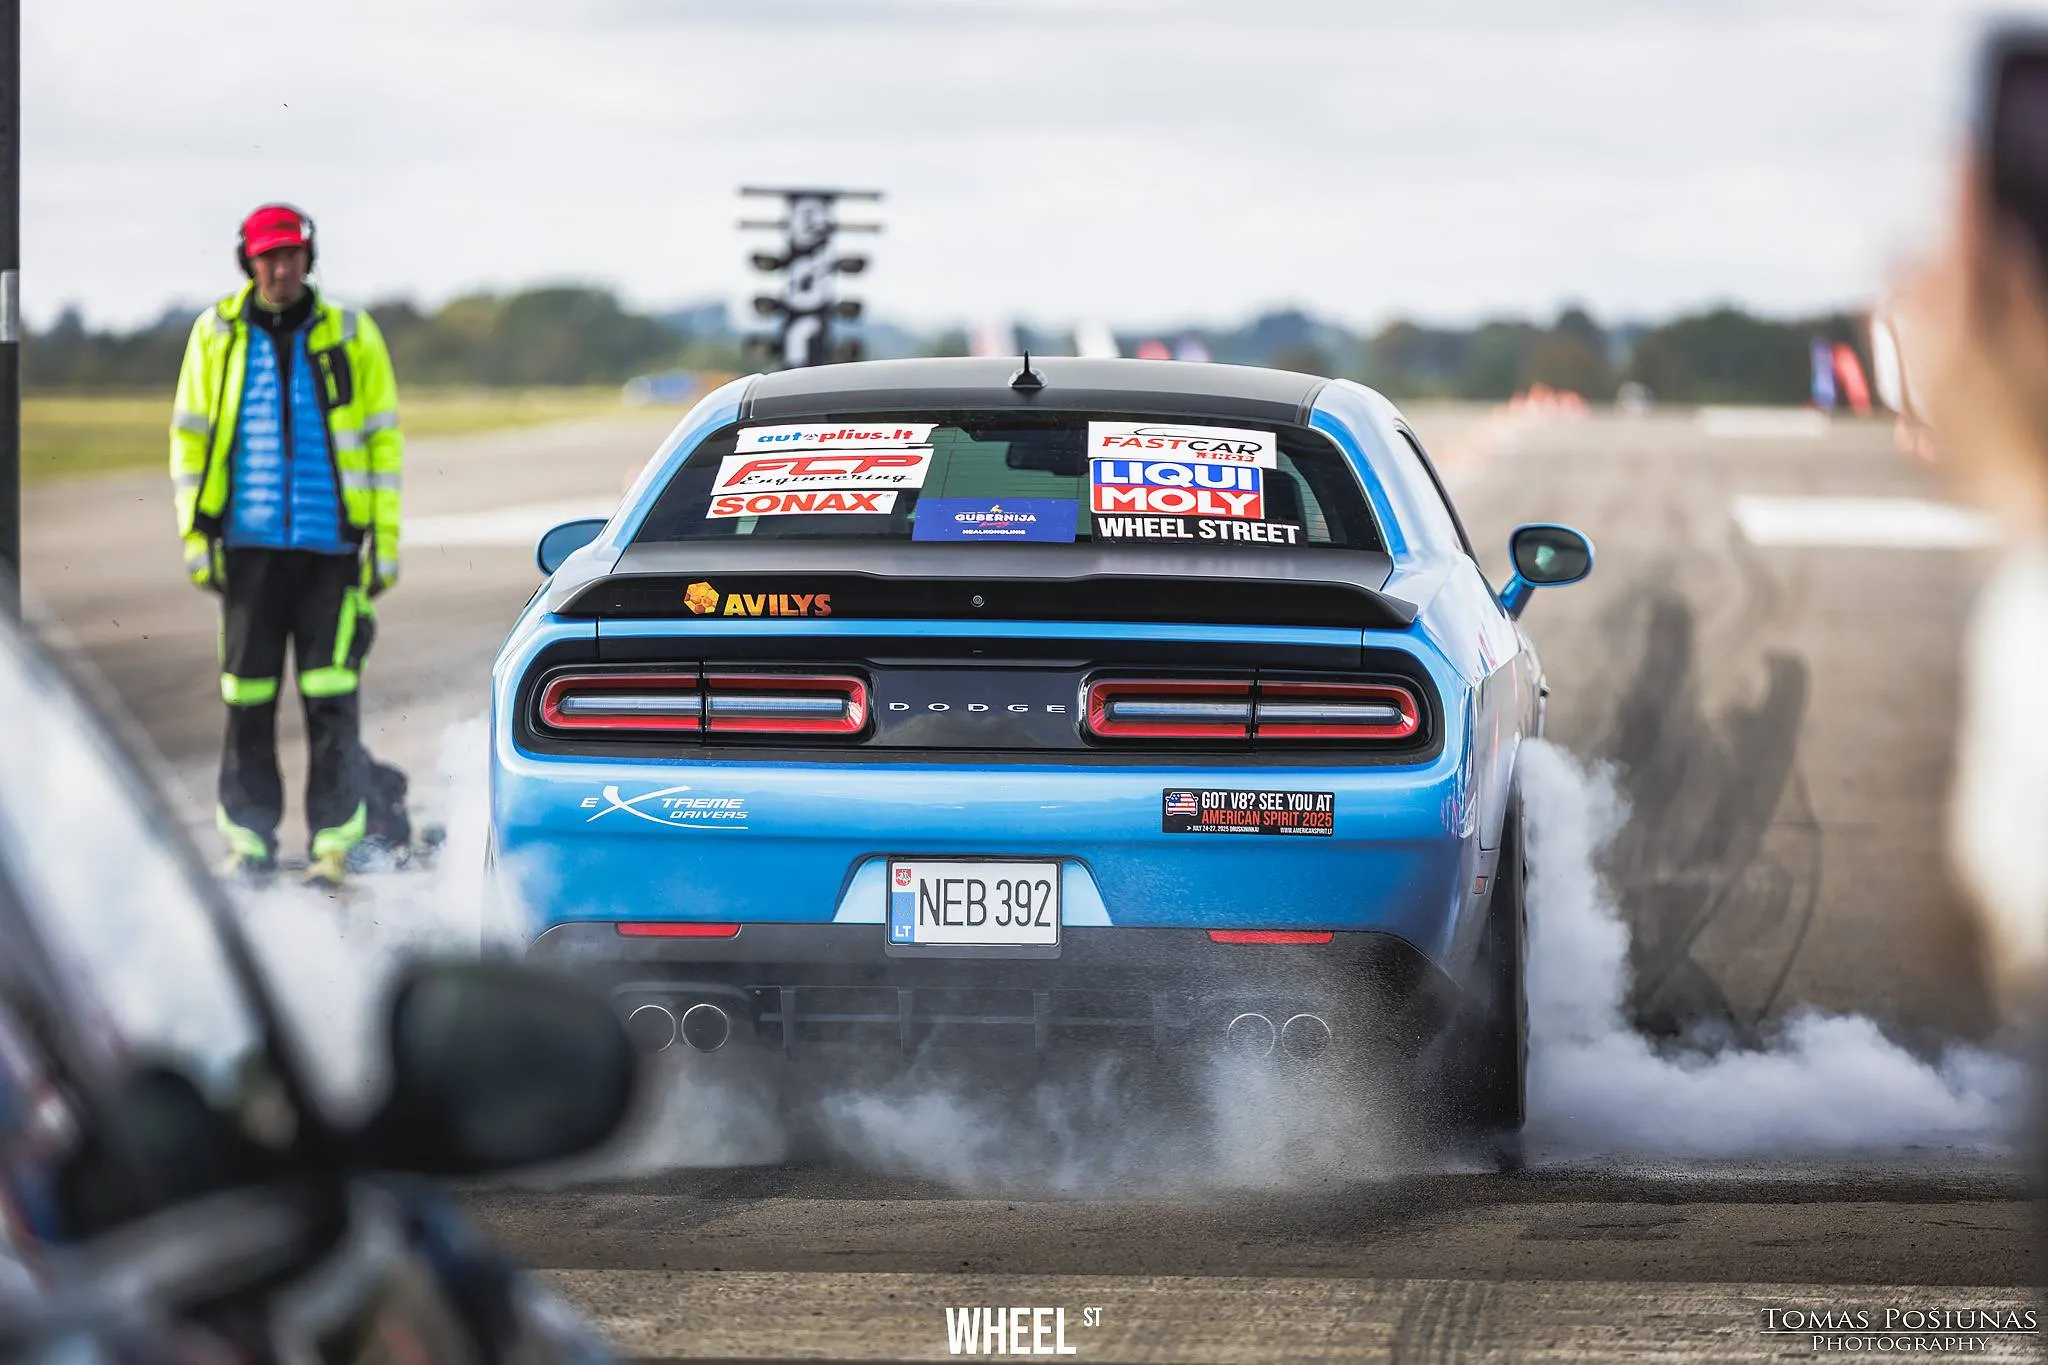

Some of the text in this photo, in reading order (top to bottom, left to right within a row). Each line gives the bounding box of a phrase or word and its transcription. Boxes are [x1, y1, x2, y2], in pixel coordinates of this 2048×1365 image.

[1102, 435, 1263, 456] FASTCAR
[722, 455, 923, 487] FCP
[739, 472, 907, 486] Engineering
[1101, 461, 1252, 490] LIQUI
[712, 493, 883, 515] SONAX
[1101, 487, 1260, 517] MOLY
[954, 513, 1037, 522] GUBERNIJA
[1098, 517, 1300, 544] WHEEL STREET
[723, 594, 832, 616] AVILYS
[889, 702, 1066, 713] DODGE
[1201, 791, 1332, 811] GOT V8? SEE YOU AT
[669, 810, 749, 819] DRIVERS
[1201, 809, 1332, 828] AMERICAN SPIRIT 2025
[919, 878, 1052, 928] NEB 392
[895, 925, 911, 937] LT
